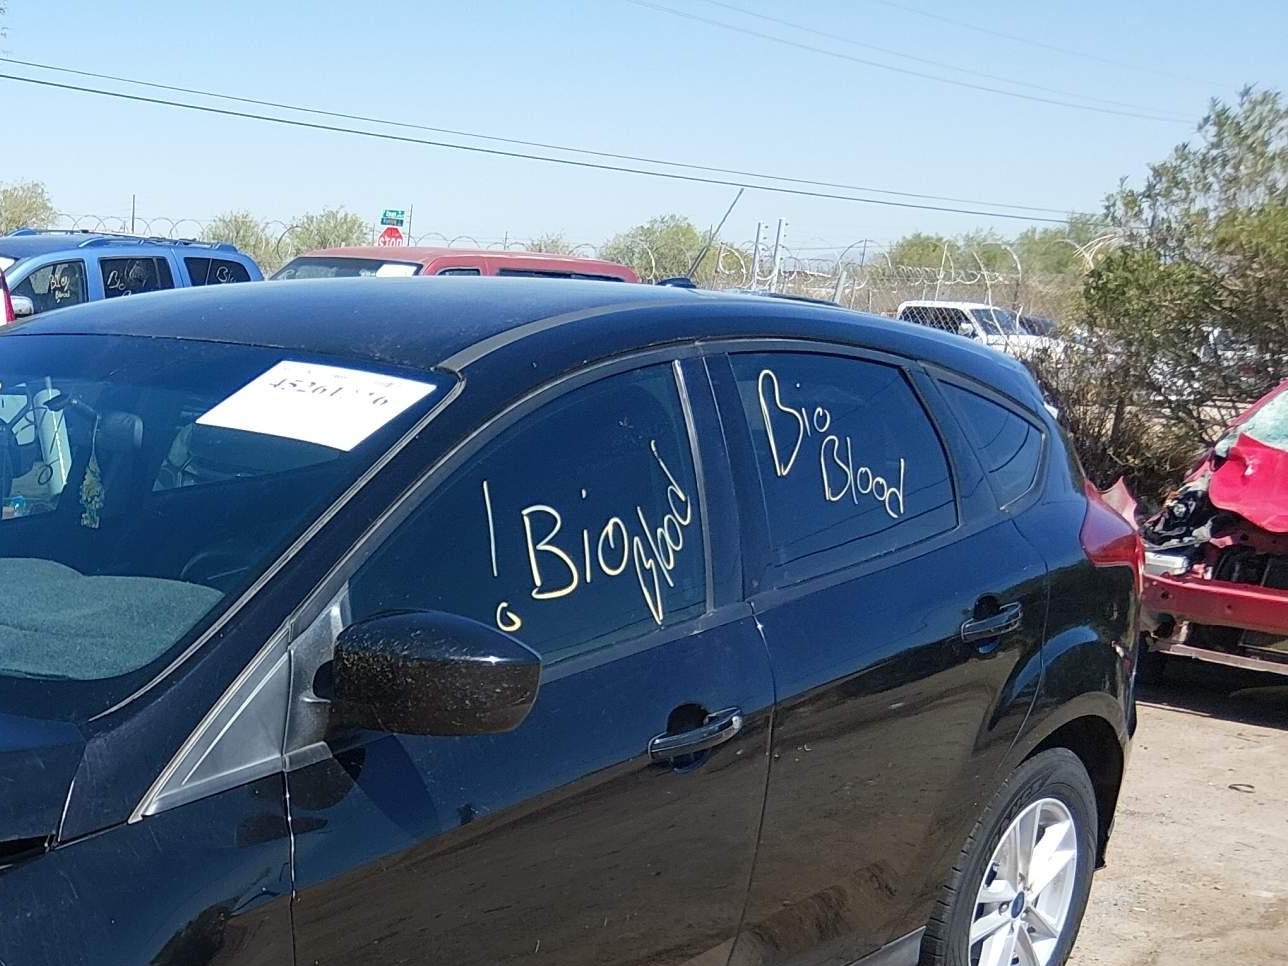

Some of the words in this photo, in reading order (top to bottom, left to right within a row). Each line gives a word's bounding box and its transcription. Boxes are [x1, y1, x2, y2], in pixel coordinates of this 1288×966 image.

[757, 368, 831, 477] Bio
[820, 435, 906, 519] Blood
[521, 488, 629, 600] Bio
